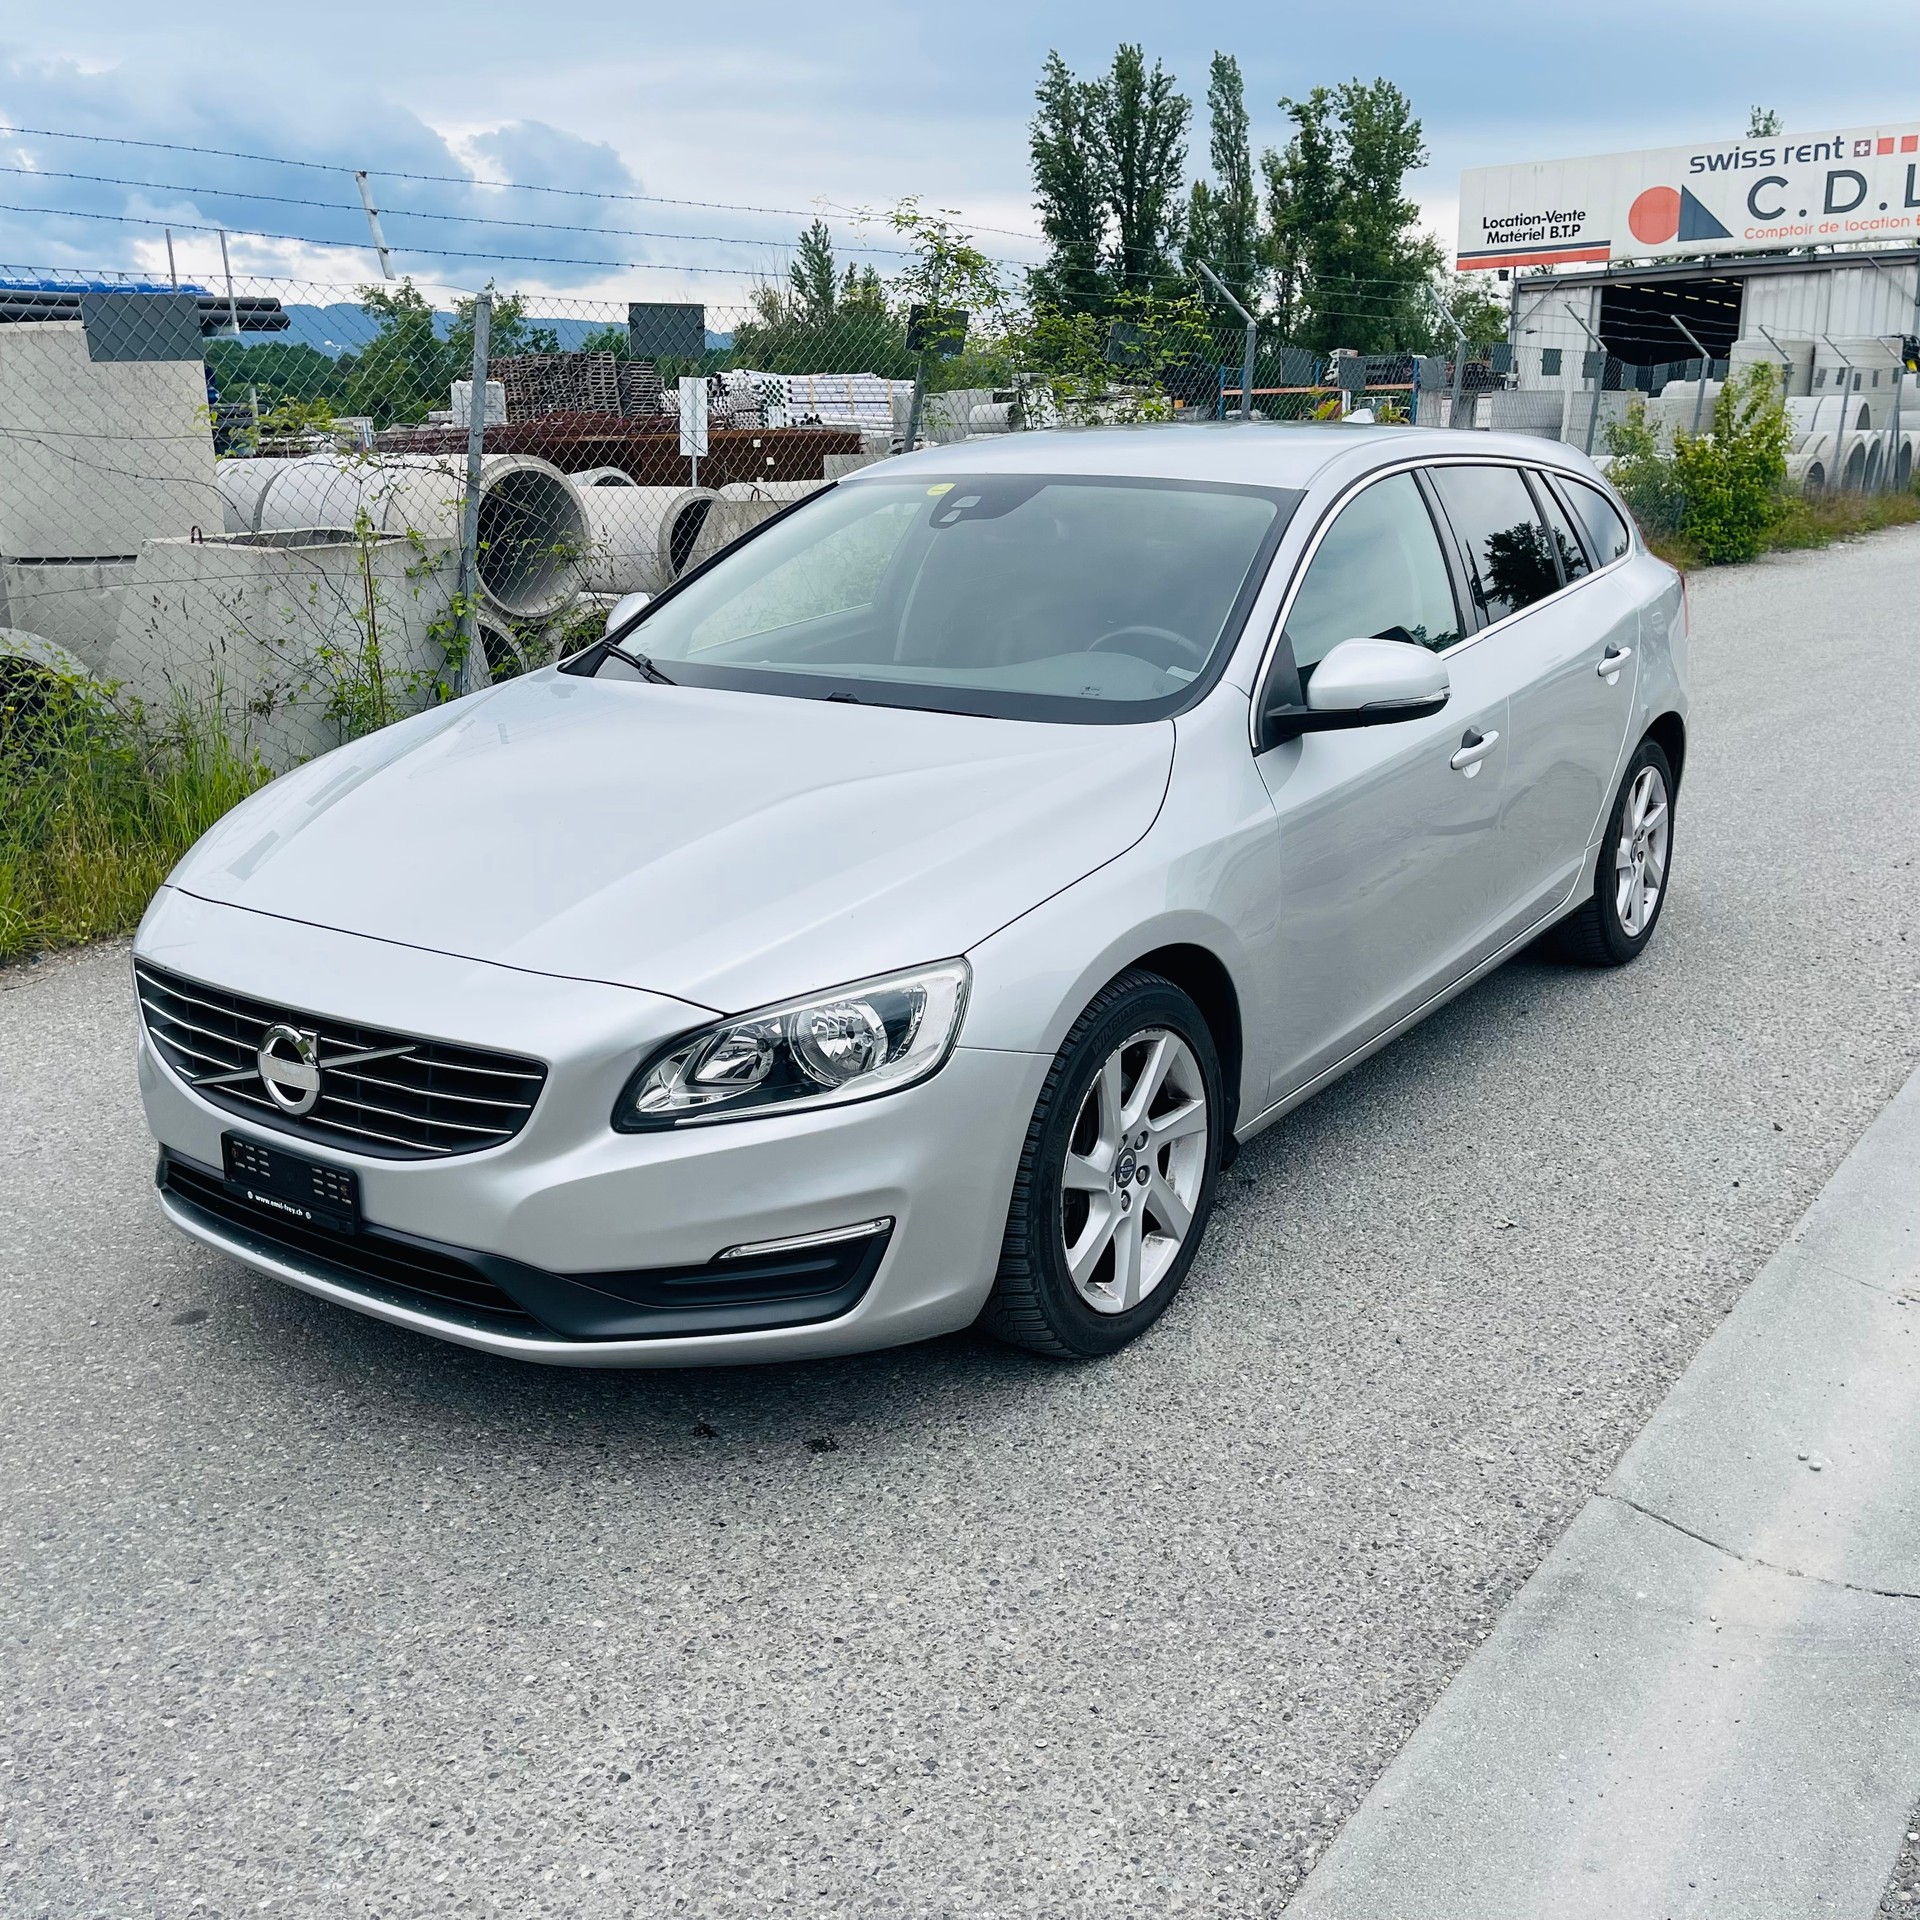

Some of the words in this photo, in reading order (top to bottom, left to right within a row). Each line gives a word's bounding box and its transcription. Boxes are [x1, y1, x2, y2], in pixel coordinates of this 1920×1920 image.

[1689, 146, 1776, 174] swiss
[1783, 136, 1845, 165] rent
[1482, 209, 1586, 229] Location-Vente
[1744, 223, 1815, 240] Comptoir
[1818, 220, 1839, 234] de
[1844, 216, 1911, 232] location
[1486, 226, 1545, 245] Matériel
[1549, 224, 1581, 239] B.T.P
